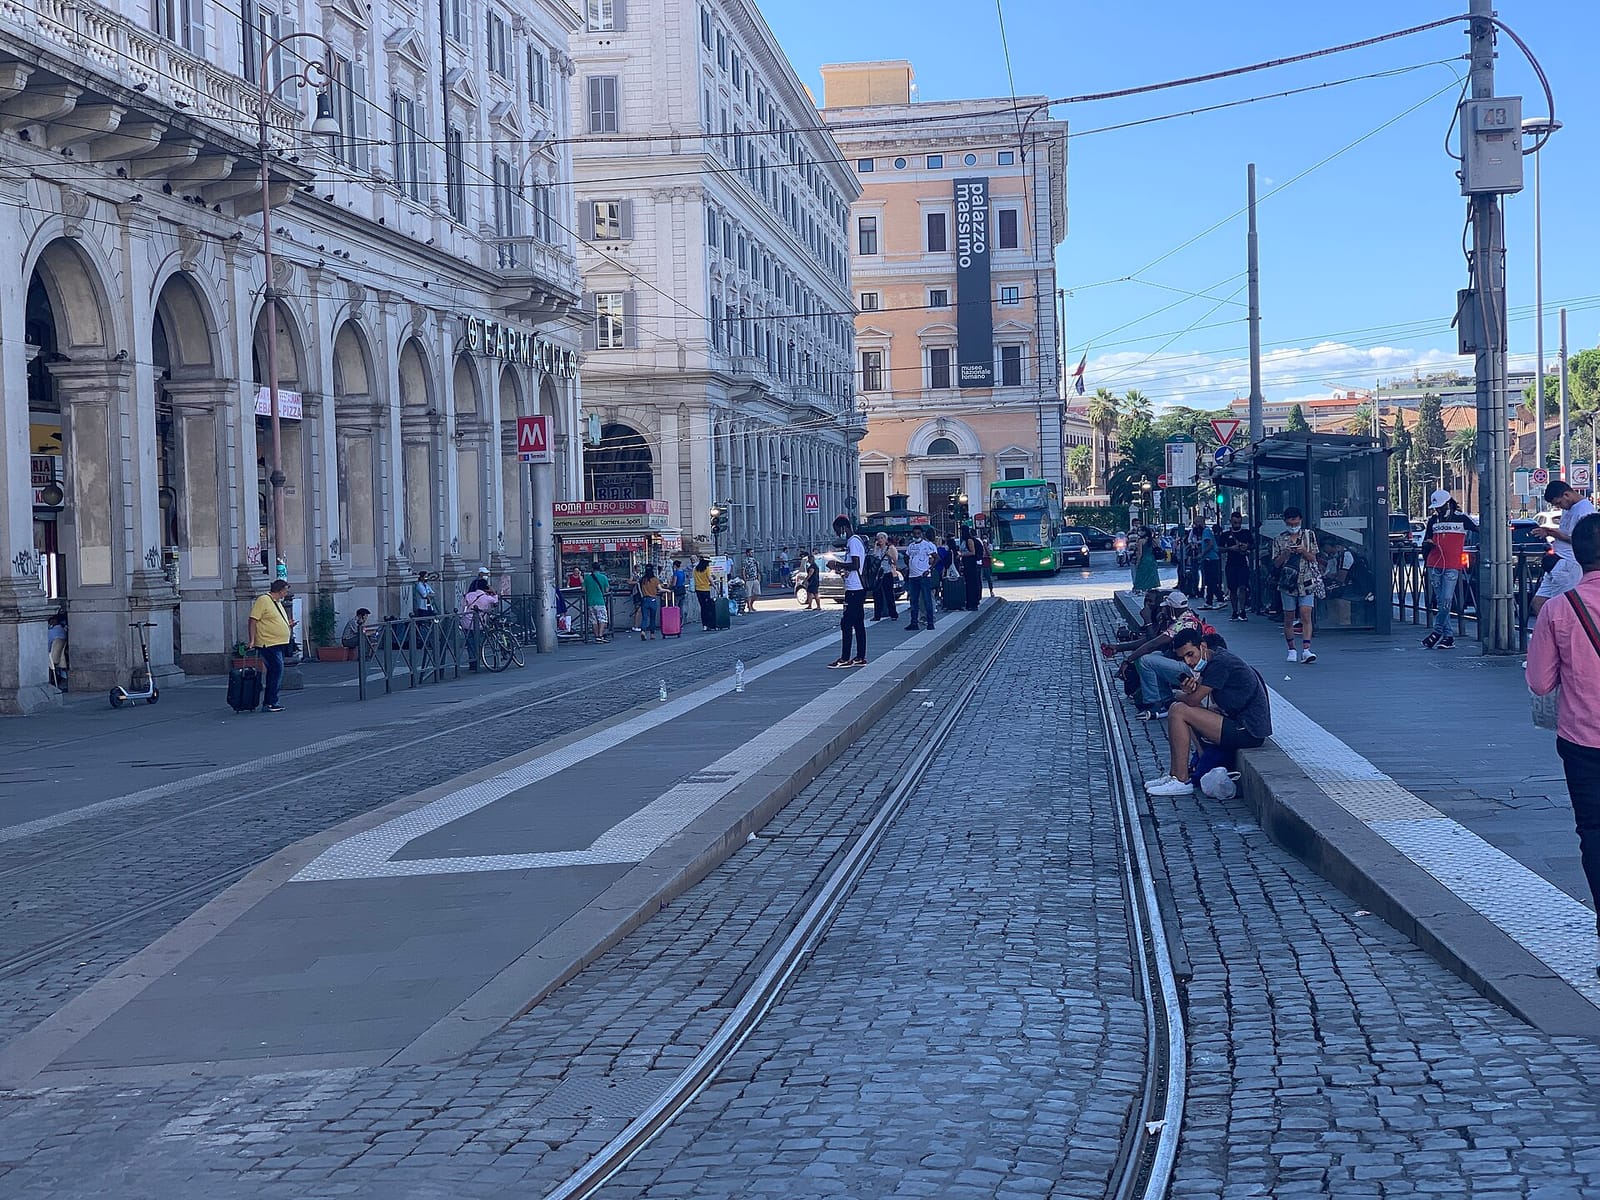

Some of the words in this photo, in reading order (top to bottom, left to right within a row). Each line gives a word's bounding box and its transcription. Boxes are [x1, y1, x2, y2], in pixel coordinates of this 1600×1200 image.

[970, 183, 988, 254] palazzo
[957, 184, 972, 268] massimo
[484, 319, 569, 379] FARMACIA
[282, 404, 302, 418] PIZZA
[520, 423, 545, 447] M
[598, 487, 633, 500] BAR
[554, 503, 582, 512] ROMA
[585, 502, 616, 510] METRO
[619, 501, 637, 510] BUS
[806, 496, 818, 506] M
[1323, 509, 1343, 517] atac
